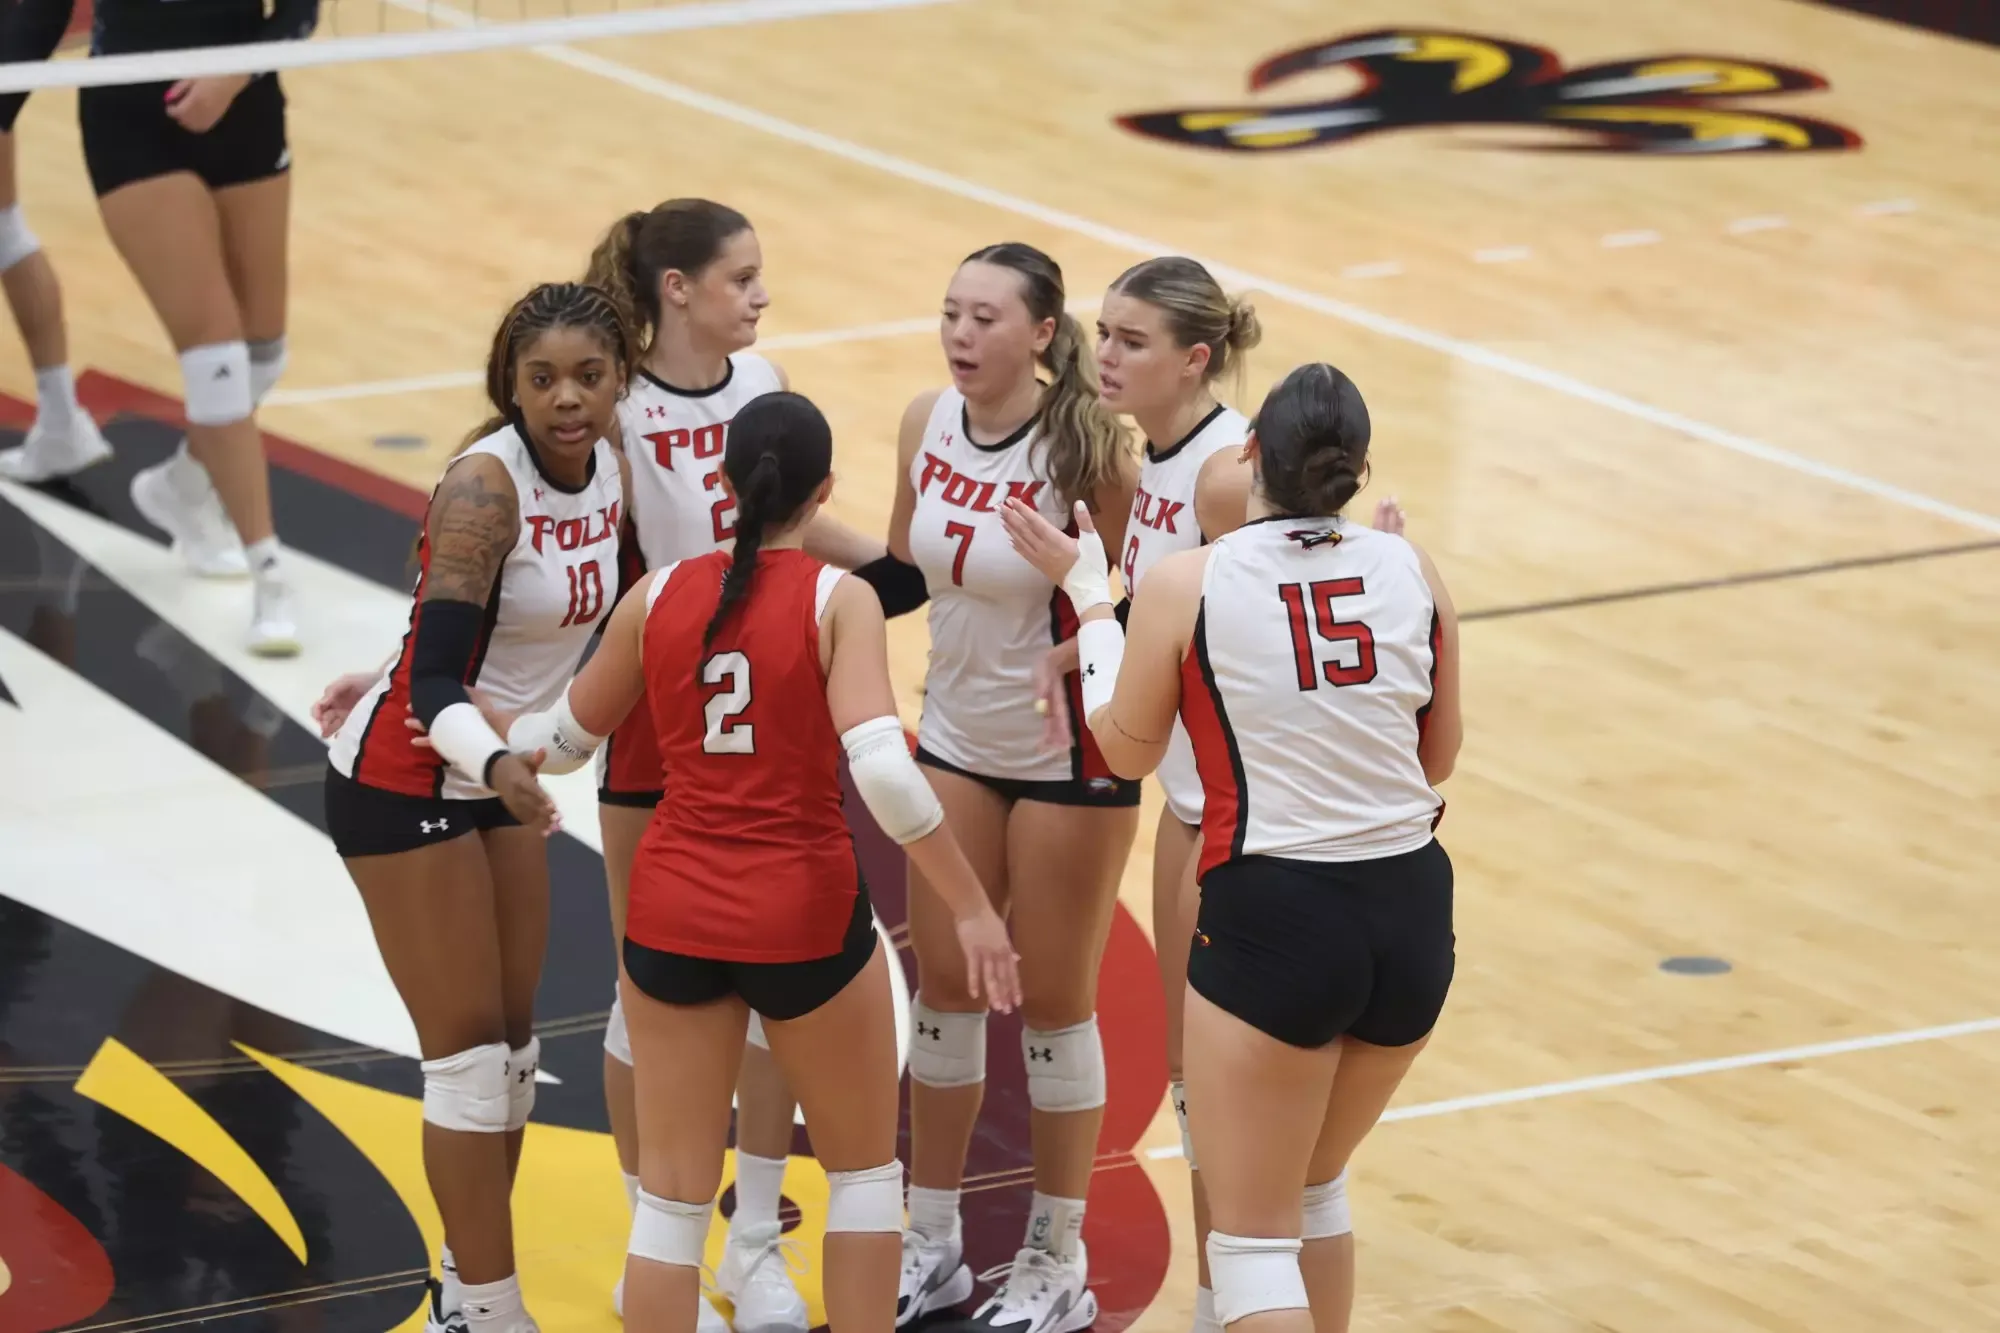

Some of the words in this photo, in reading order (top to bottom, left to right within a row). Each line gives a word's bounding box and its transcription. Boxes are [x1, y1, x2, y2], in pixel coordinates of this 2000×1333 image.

[640, 419, 732, 472] PO
[919, 451, 1047, 513] POLK
[1133, 486, 1186, 535] OLK
[525, 499, 620, 556] POLK
[944, 520, 976, 587] 7
[558, 559, 604, 628] 10
[1278, 576, 1378, 692] 15
[703, 650, 756, 755] 2
